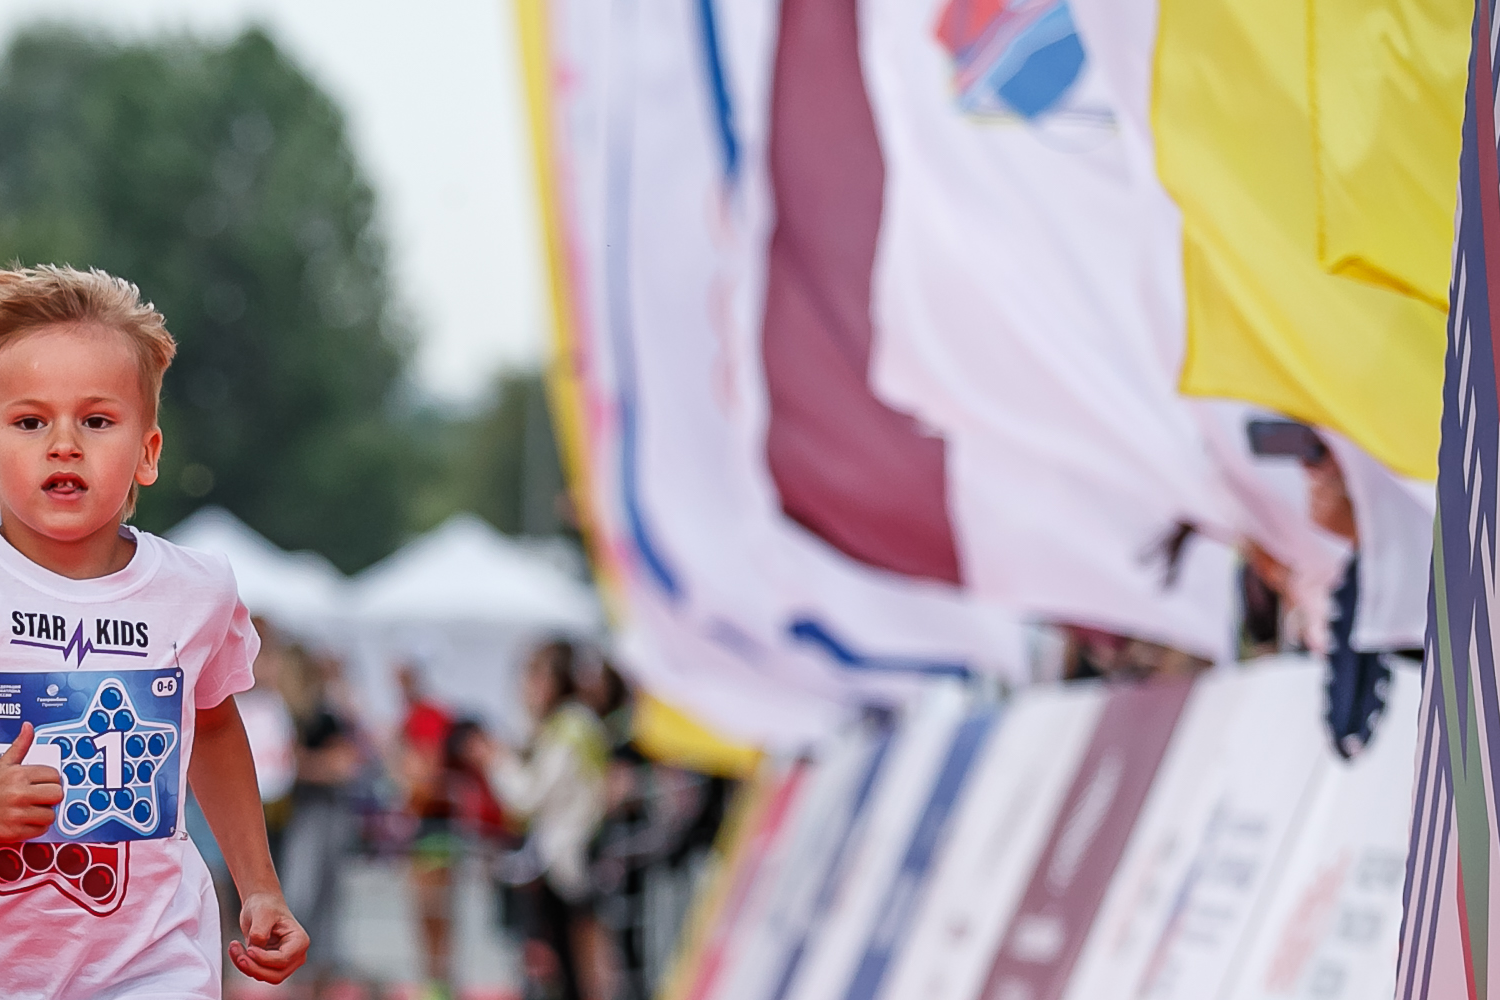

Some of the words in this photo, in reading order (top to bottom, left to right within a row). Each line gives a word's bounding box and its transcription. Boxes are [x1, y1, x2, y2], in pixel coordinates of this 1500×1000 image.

[11, 610, 66, 642] STAR
[96, 618, 149, 648] KIDS
[157, 680, 173, 692] 0-6
[0, 703, 21, 715] KIDS
[92, 731, 122, 789] 1
